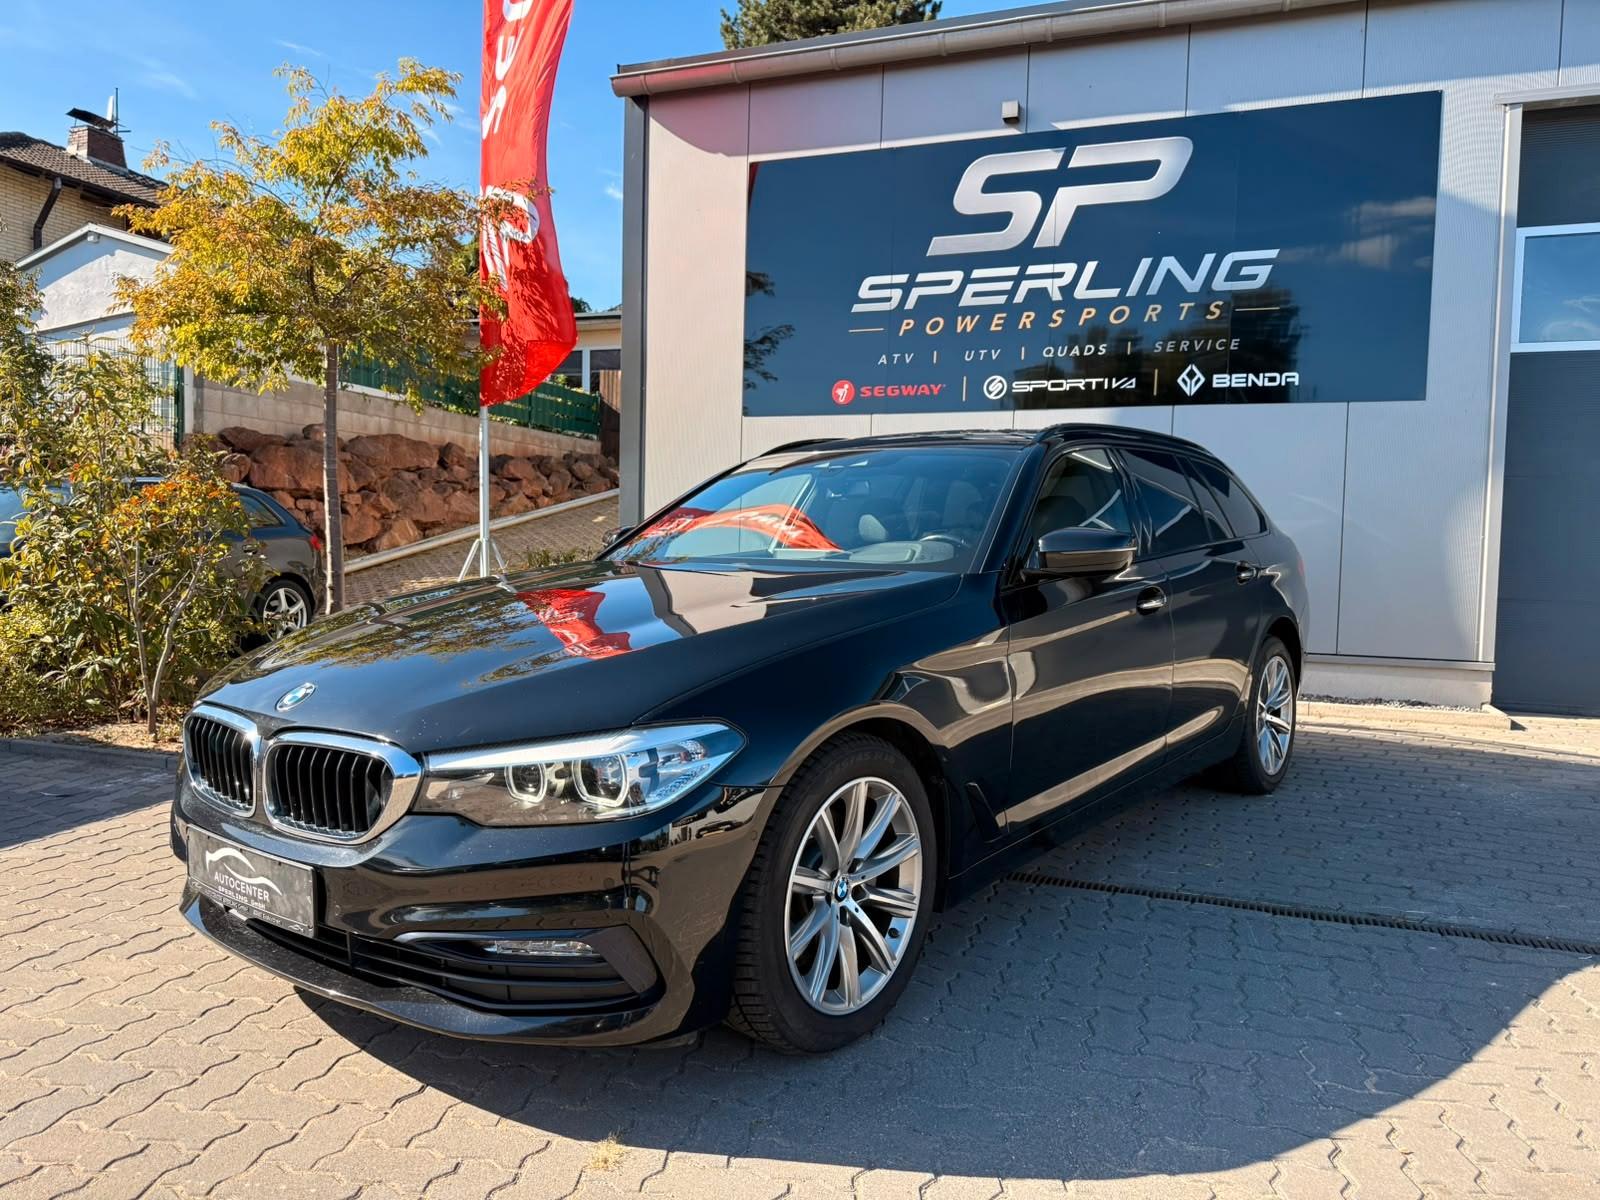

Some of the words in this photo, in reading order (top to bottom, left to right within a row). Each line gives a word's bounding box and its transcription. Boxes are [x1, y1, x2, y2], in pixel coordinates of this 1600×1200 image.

[926, 136, 1194, 257] SP
[850, 248, 1281, 313] SPERLING
[898, 300, 1225, 337] POWERSPORTS
[877, 352, 915, 366] ATV
[963, 348, 1002, 361] UTV
[1042, 343, 1108, 359] QUADS
[1153, 338, 1242, 354] SERVICE
[859, 383, 942, 398] SEGWAY
[1011, 377, 1137, 393] SPORTIVA
[1212, 371, 1300, 389] BENDA
[213, 871, 271, 903] AUTOCENTER
